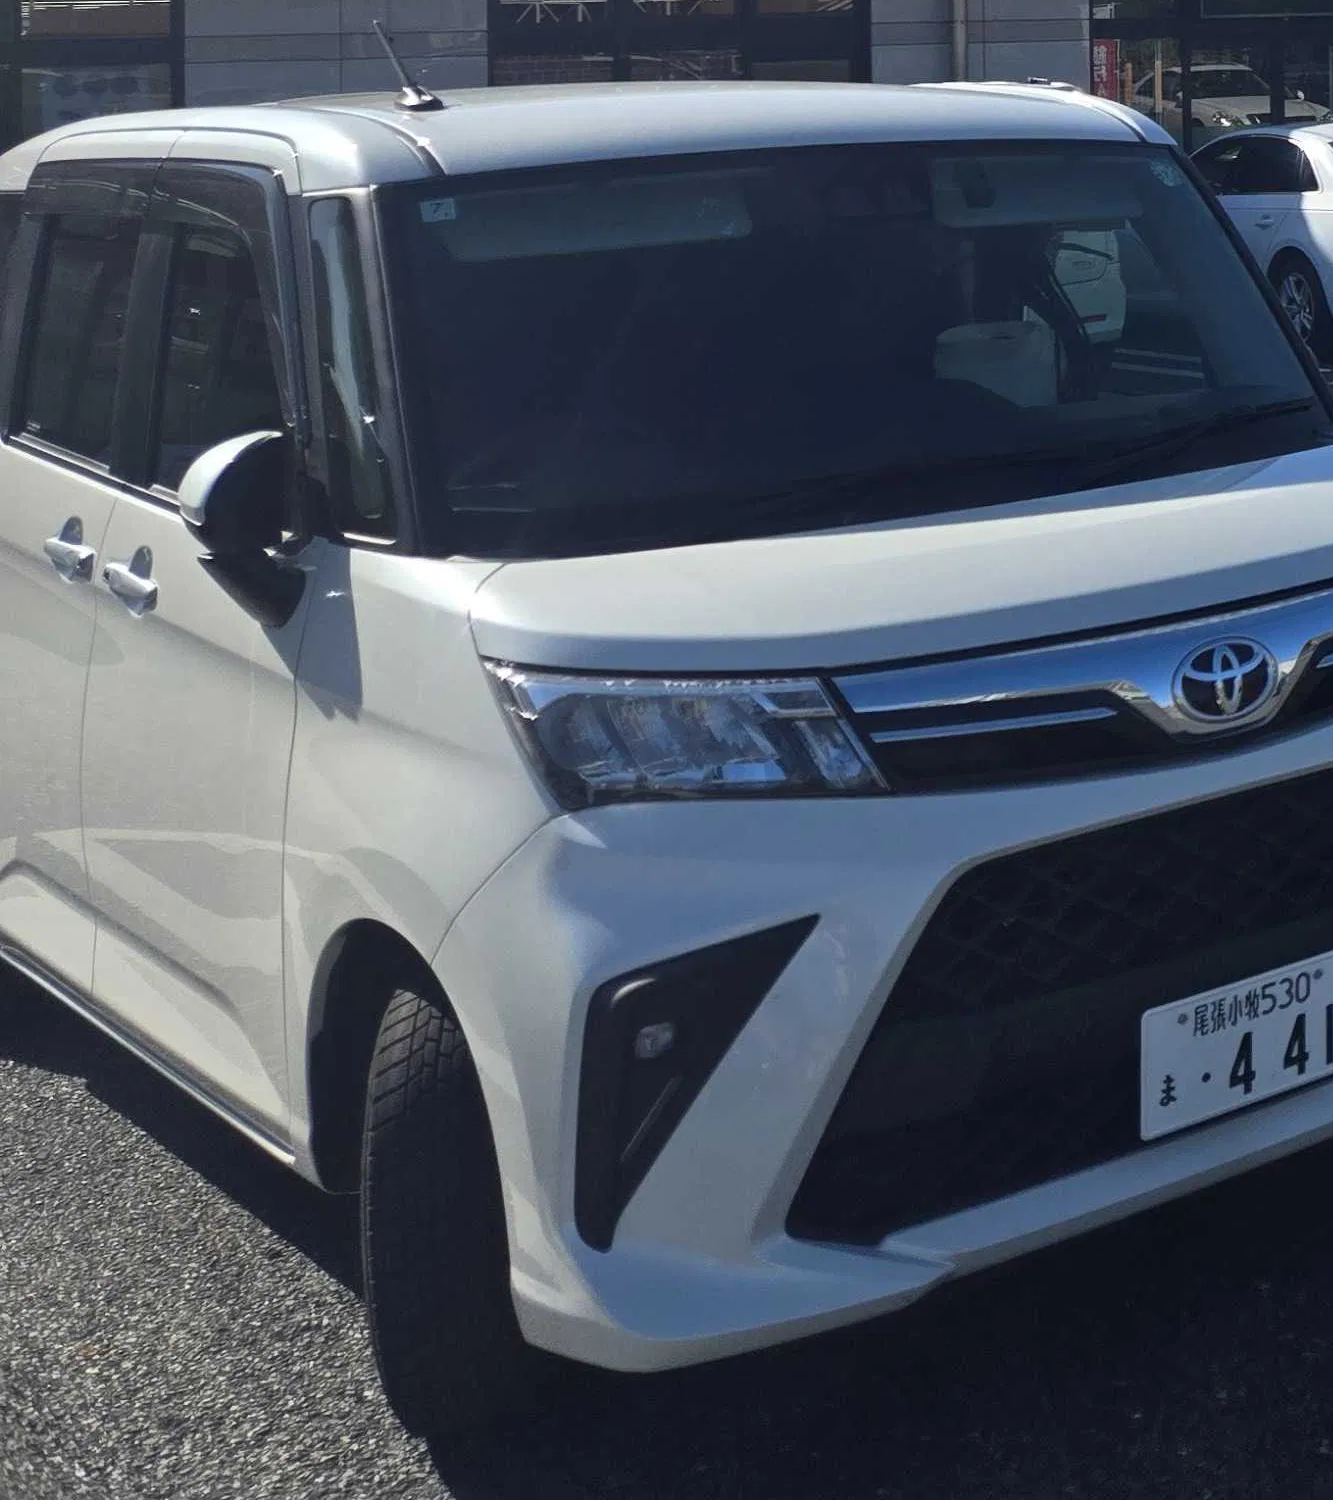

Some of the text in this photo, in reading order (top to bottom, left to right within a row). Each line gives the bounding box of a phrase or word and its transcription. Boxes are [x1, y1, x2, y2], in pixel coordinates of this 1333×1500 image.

[1193, 972, 1311, 1038] 尾張小牧530
[1159, 1074, 1177, 1107] ま
